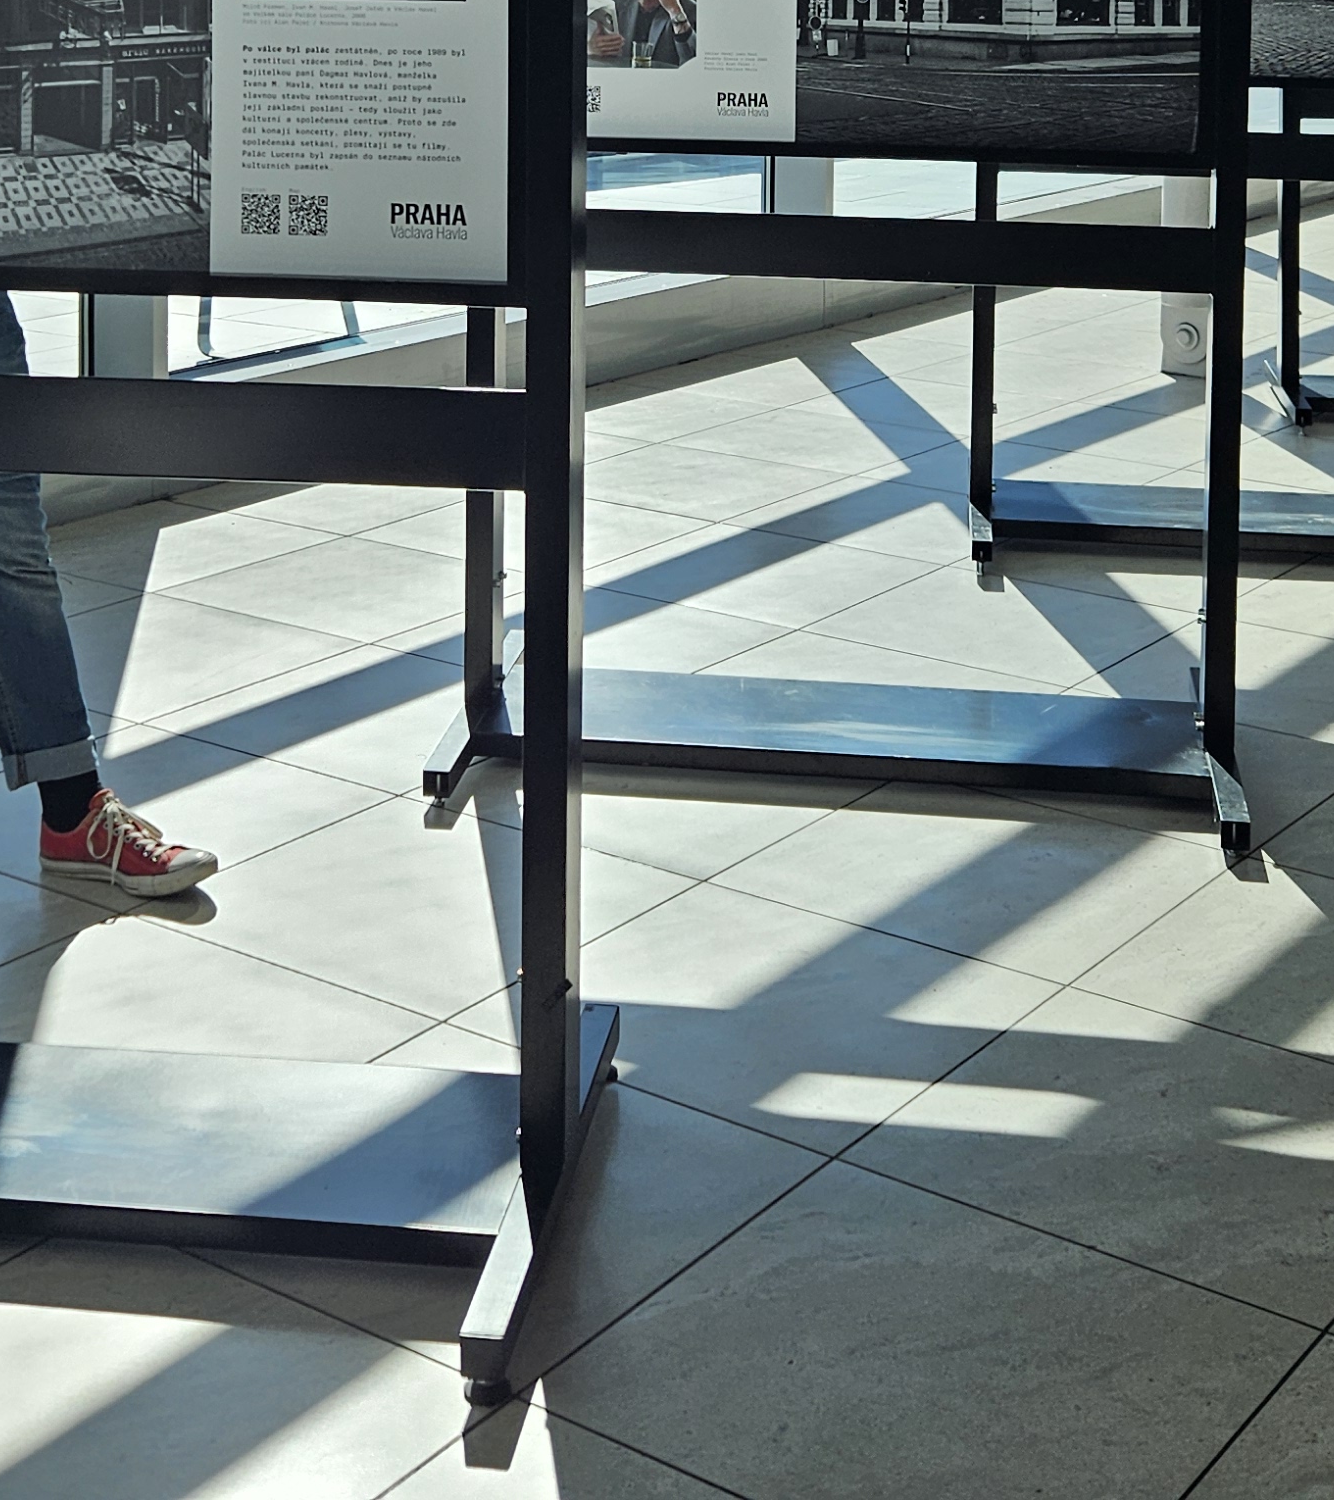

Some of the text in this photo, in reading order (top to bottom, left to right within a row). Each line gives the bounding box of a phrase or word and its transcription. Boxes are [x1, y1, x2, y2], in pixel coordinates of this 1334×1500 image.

[717, 92, 769, 108] PRAHA
[391, 202, 467, 226] PRAHA
[390, 226, 468, 240] Václava Havla
